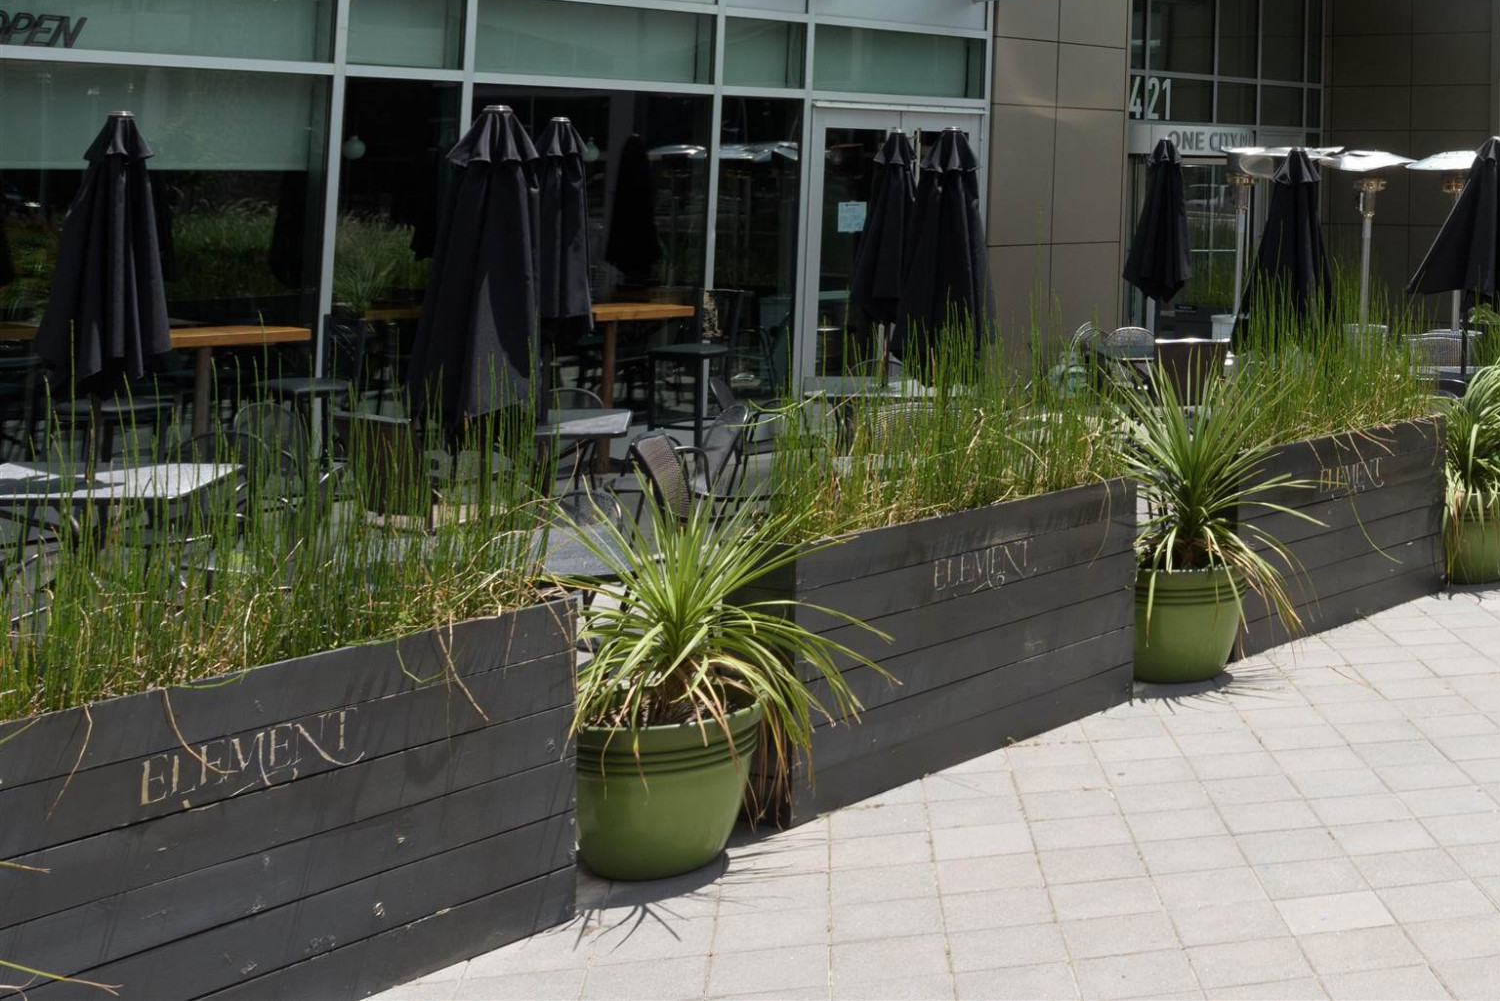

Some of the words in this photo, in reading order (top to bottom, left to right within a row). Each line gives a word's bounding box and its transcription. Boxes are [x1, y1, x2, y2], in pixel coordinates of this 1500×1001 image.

[1129, 75, 1172, 120] 421
[1167, 130, 1205, 150] ONE
[934, 536, 1038, 597] ELEMENT
[140, 706, 366, 812] ELEMENT
